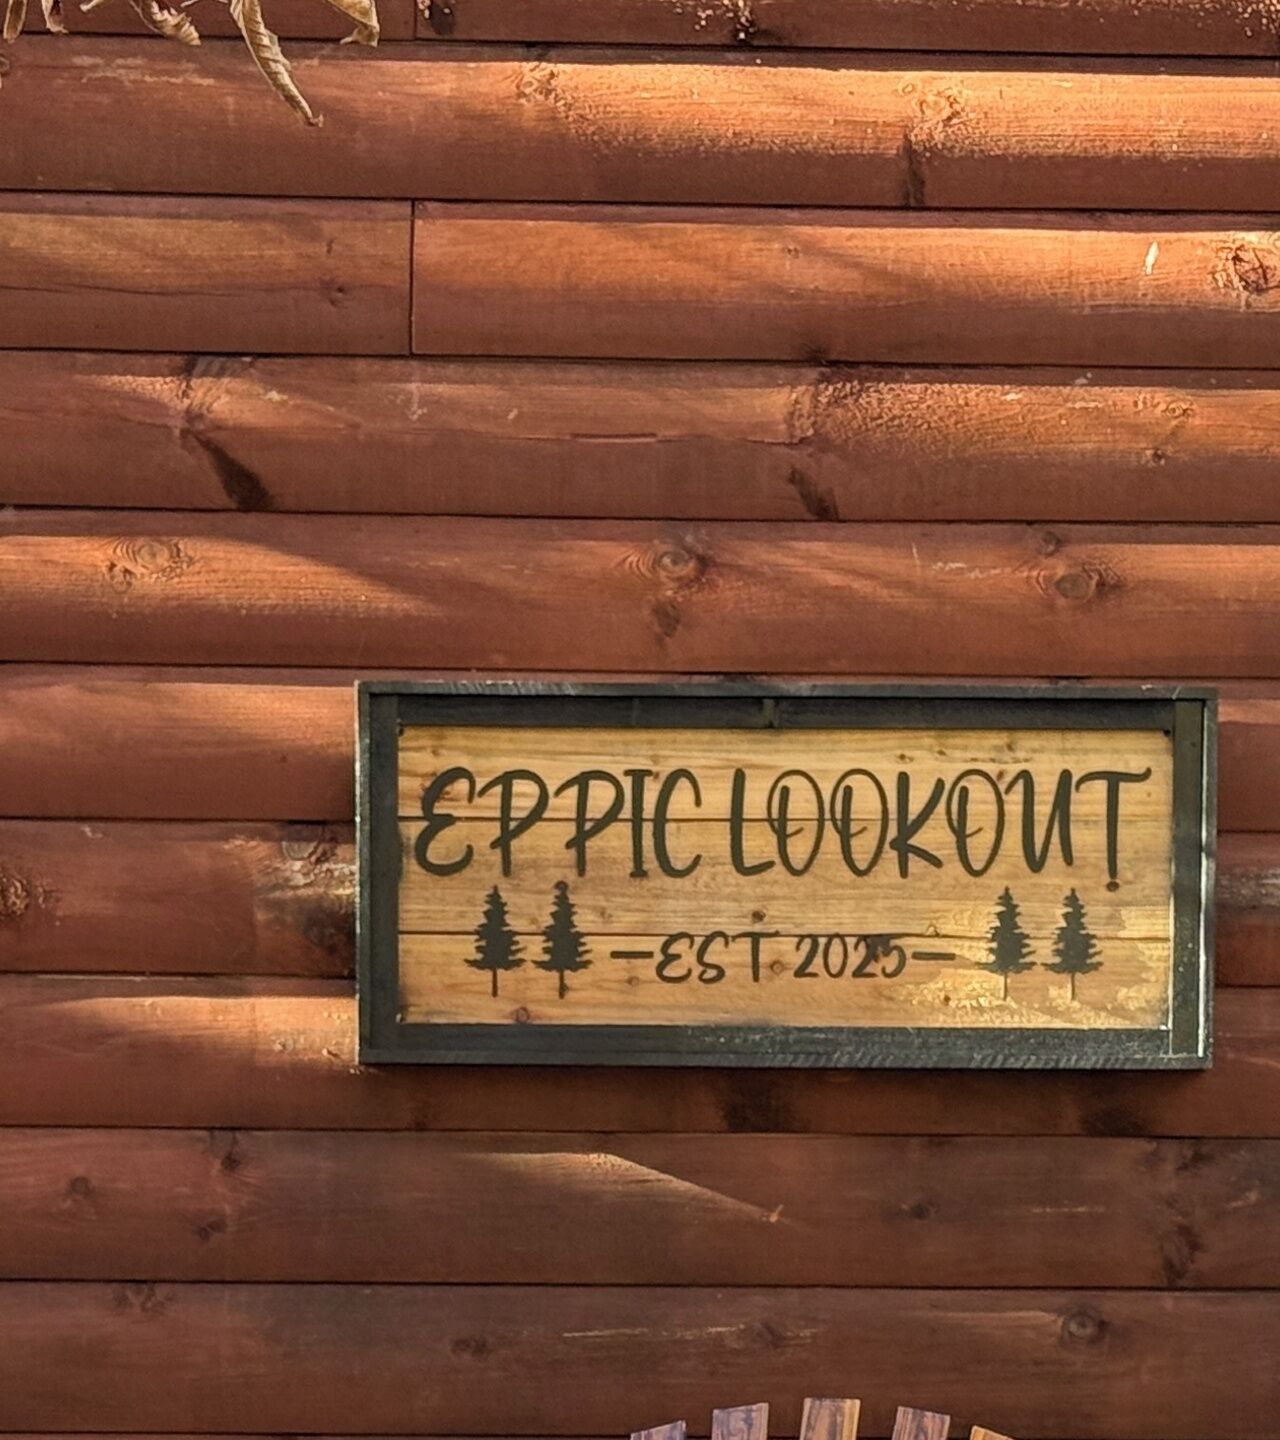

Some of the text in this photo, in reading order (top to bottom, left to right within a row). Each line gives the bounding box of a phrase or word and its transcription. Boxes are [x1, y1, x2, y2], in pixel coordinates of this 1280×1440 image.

[413, 766, 1153, 880] EPPIC LOOKOUT
[655, 930, 907, 984] EST 2025
